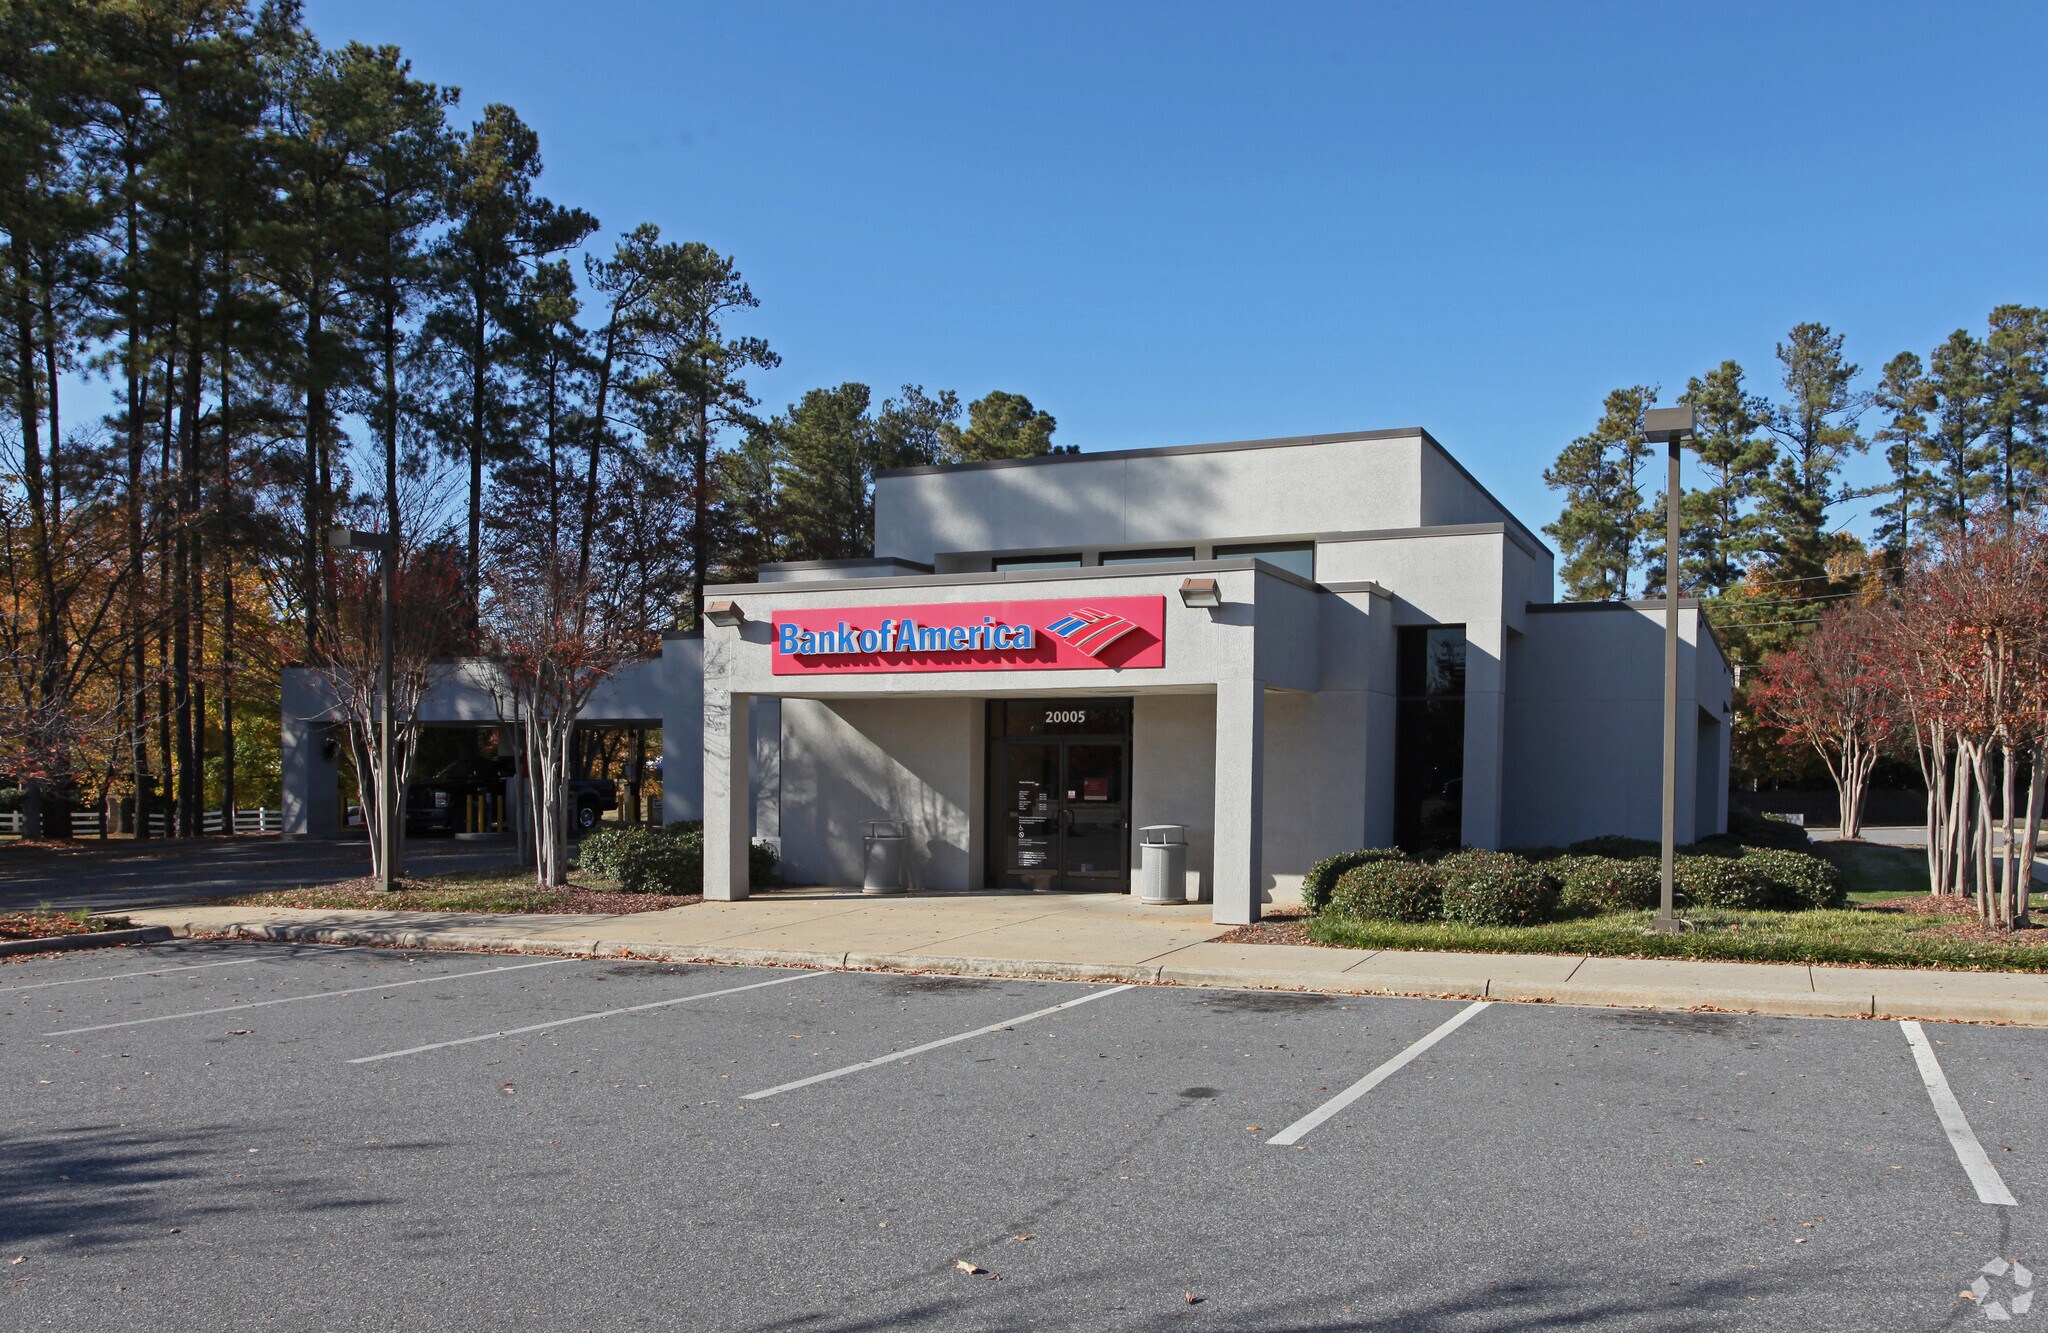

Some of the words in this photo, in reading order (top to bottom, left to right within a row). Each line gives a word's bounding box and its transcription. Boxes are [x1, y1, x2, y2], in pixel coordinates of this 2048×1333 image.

[779, 621, 860, 655] Bank
[859, 619, 897, 653] of
[895, 616, 1034, 652] America
[1045, 710, 1086, 723] 20005
